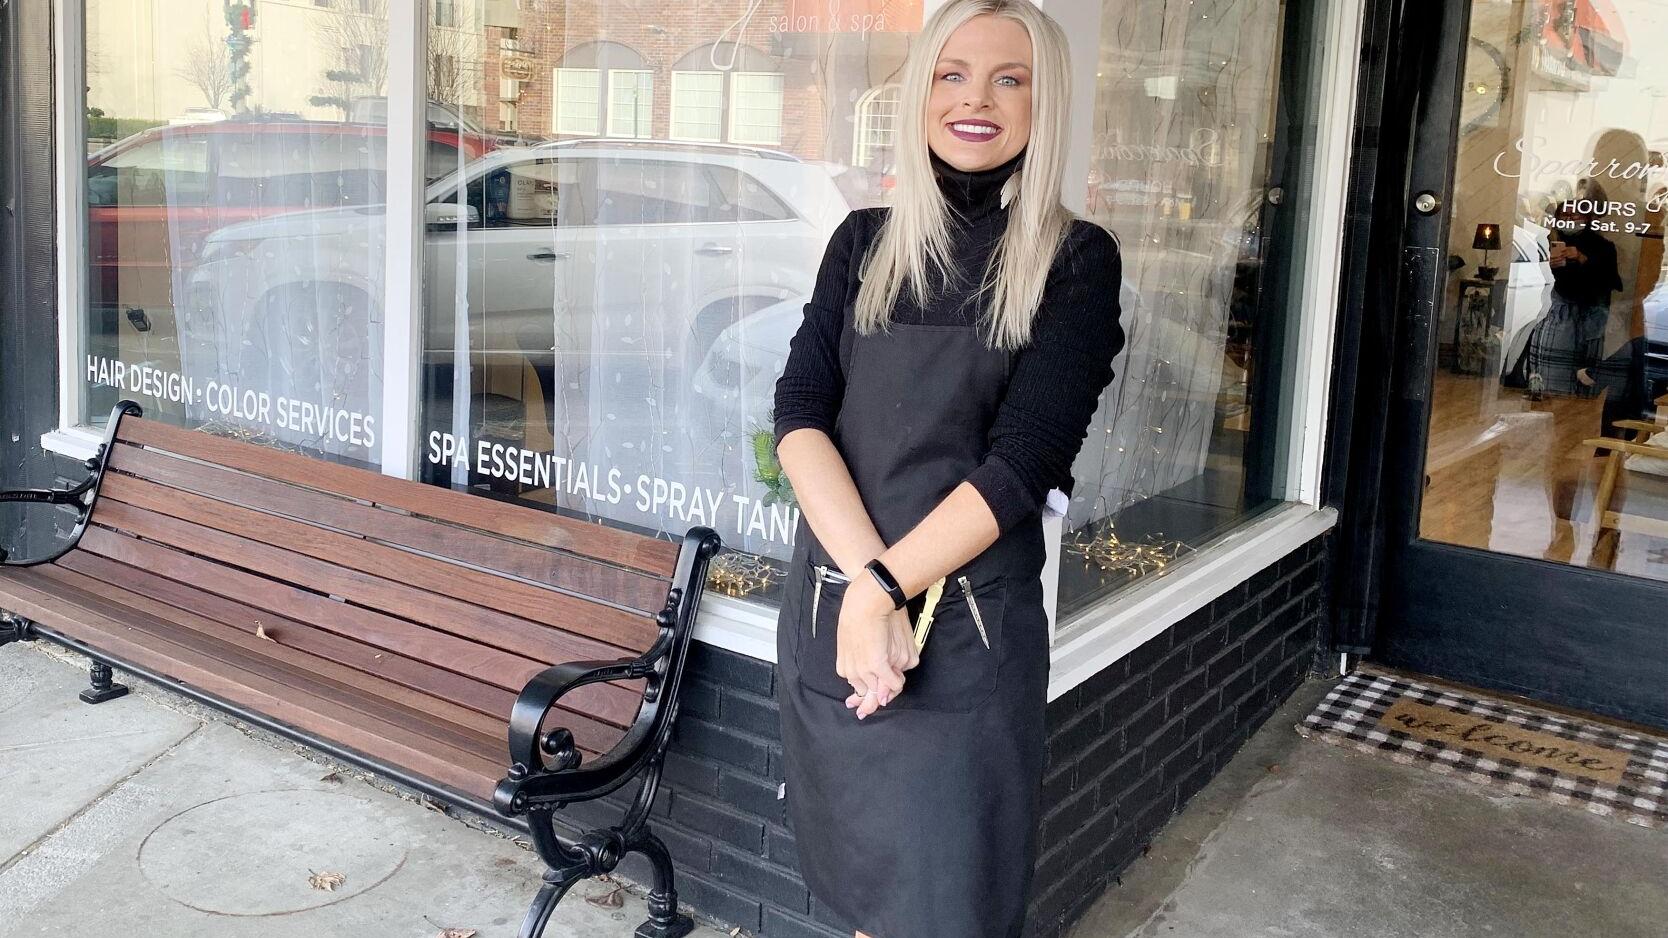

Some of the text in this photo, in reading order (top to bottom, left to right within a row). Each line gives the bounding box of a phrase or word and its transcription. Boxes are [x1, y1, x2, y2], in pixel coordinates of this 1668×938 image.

[769, 13, 886, 42] salon & spa
[1543, 216, 1575, 229] Mon
[1590, 220, 1620, 232] Sat.
[1624, 222, 1651, 234] 9-7
[1562, 199, 1637, 217] HOURS
[86, 354, 376, 448] HAIR DESIGN COLOR SERVICES
[428, 430, 470, 472] SPA
[476, 440, 622, 504] ESSENTIALS
[636, 474, 725, 528] SPRAY
[1394, 713, 1614, 771] welcome
